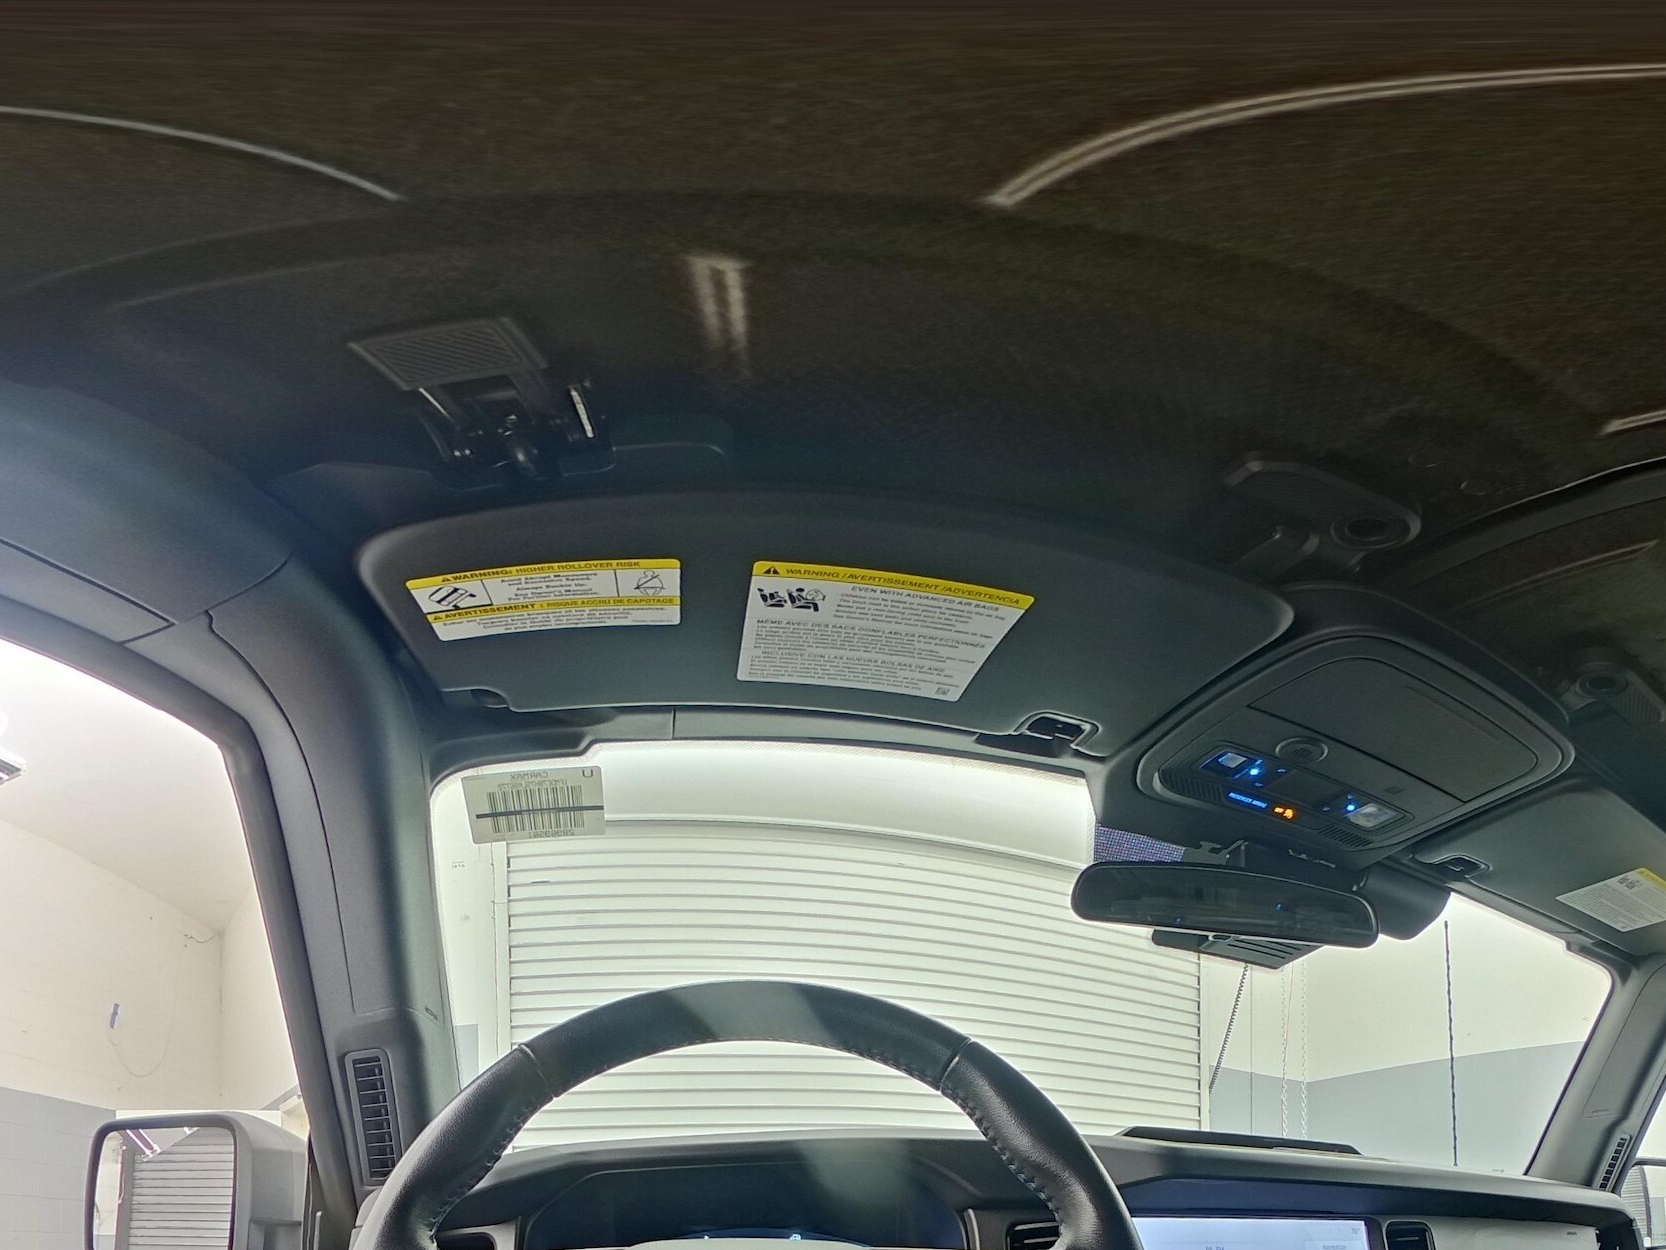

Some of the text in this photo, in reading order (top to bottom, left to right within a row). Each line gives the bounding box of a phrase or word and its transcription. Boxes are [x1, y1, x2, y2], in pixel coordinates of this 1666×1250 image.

[452, 569, 513, 581] WARNING:
[516, 565, 554, 574] HIGHER
[557, 562, 613, 570] ROLLOVER
[785, 568, 840, 578] WARNING
[444, 603, 536, 619] AVERTISSEMENT
[546, 600, 578, 608] RISQUE
[880, 589, 903, 597] WITH
[905, 593, 956, 604] ADVANCED
[974, 603, 999, 611] BAGS
